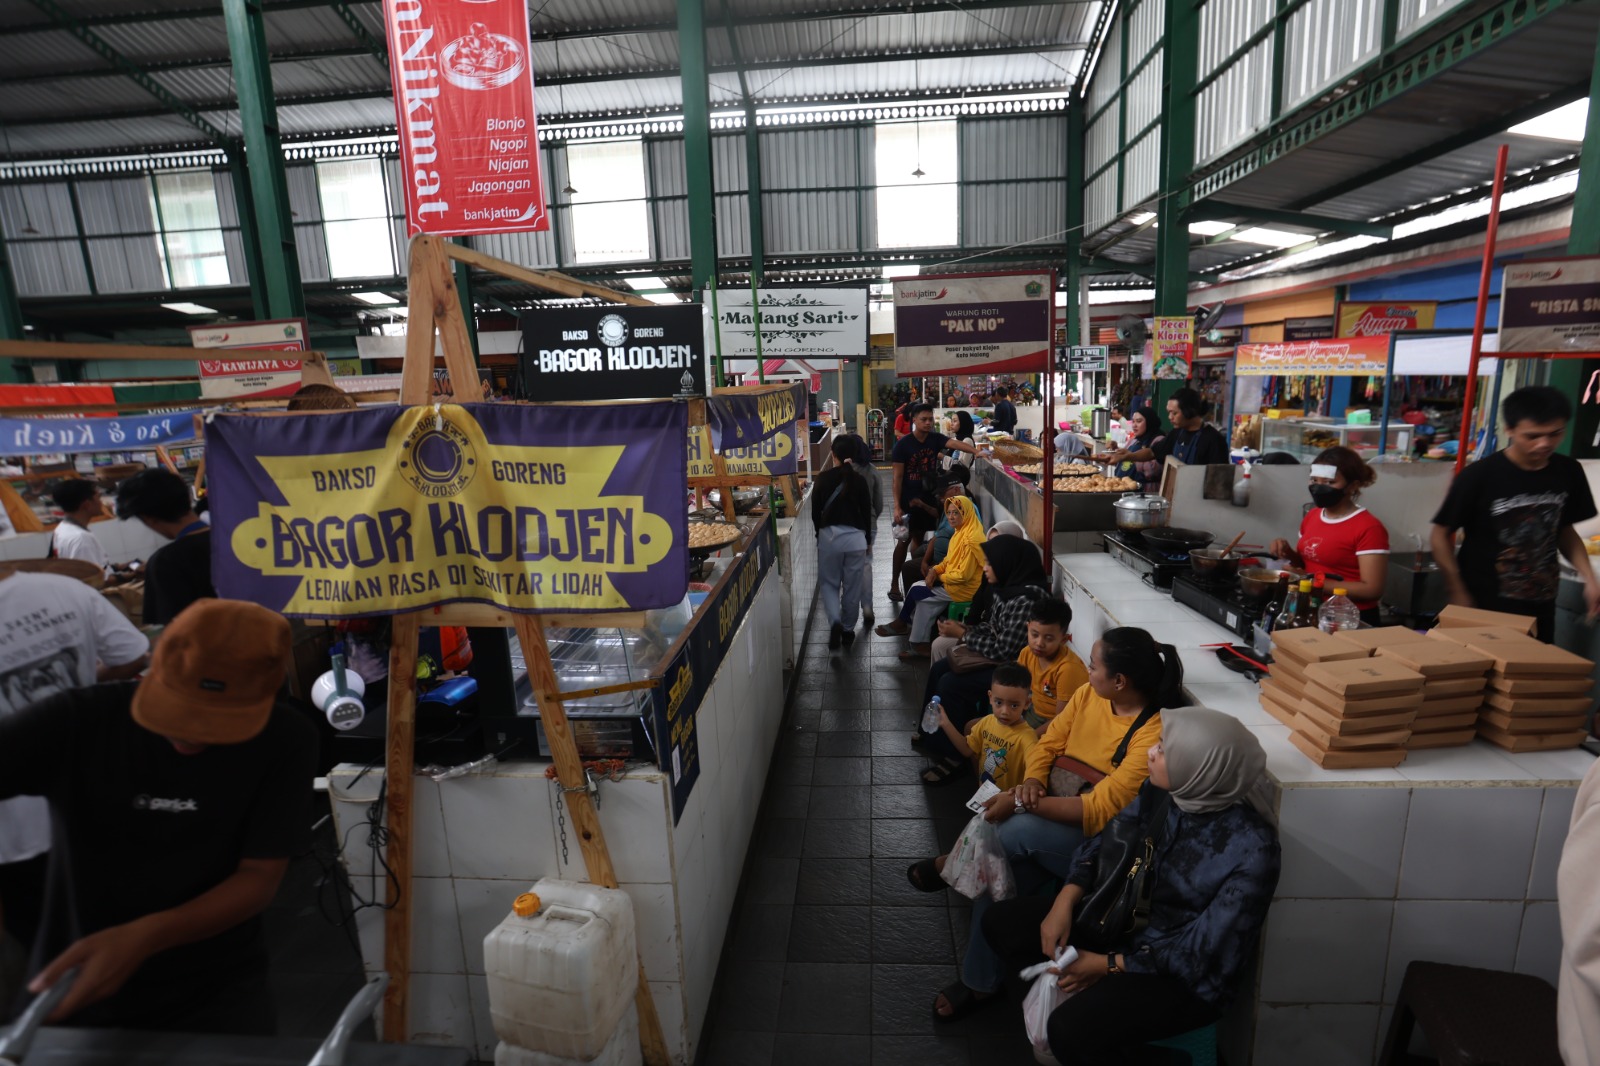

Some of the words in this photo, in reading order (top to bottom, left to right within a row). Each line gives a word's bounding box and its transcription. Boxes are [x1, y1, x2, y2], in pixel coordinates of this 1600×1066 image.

[486, 118, 526, 132] Blonjo
[490, 136, 528, 153] Ngopi
[488, 159, 529, 174] Njajan
[468, 178, 531, 195] Jagongan
[464, 207, 520, 222] bankjatim
[901, 289, 937, 299] bankjatim
[802, 310, 844, 324] Sari
[946, 309, 980, 317] WARUNG
[982, 308, 999, 316] ROTI
[1161, 319, 1188, 329] Pecel
[562, 330, 589, 341] BAKSO
[634, 328, 664, 338] GORENG
[1157, 330, 1189, 340] Klojen
[539, 348, 602, 373] BAGOR
[608, 345, 691, 371] KLODJEN
[417, 415, 449, 432] BAGR
[312, 465, 376, 493] BAKSO
[492, 460, 566, 486] GORENG
[272, 507, 413, 570] BAGOR
[428, 501, 635, 567] KLODJEN
[306, 575, 384, 602] LEDAKAN
[388, 570, 439, 598] RASA
[449, 564, 468, 586] DI
[474, 570, 543, 597] SEKITAR
[552, 572, 603, 597] LIDAH
[988, 733, 1015, 751] SUNDAY
